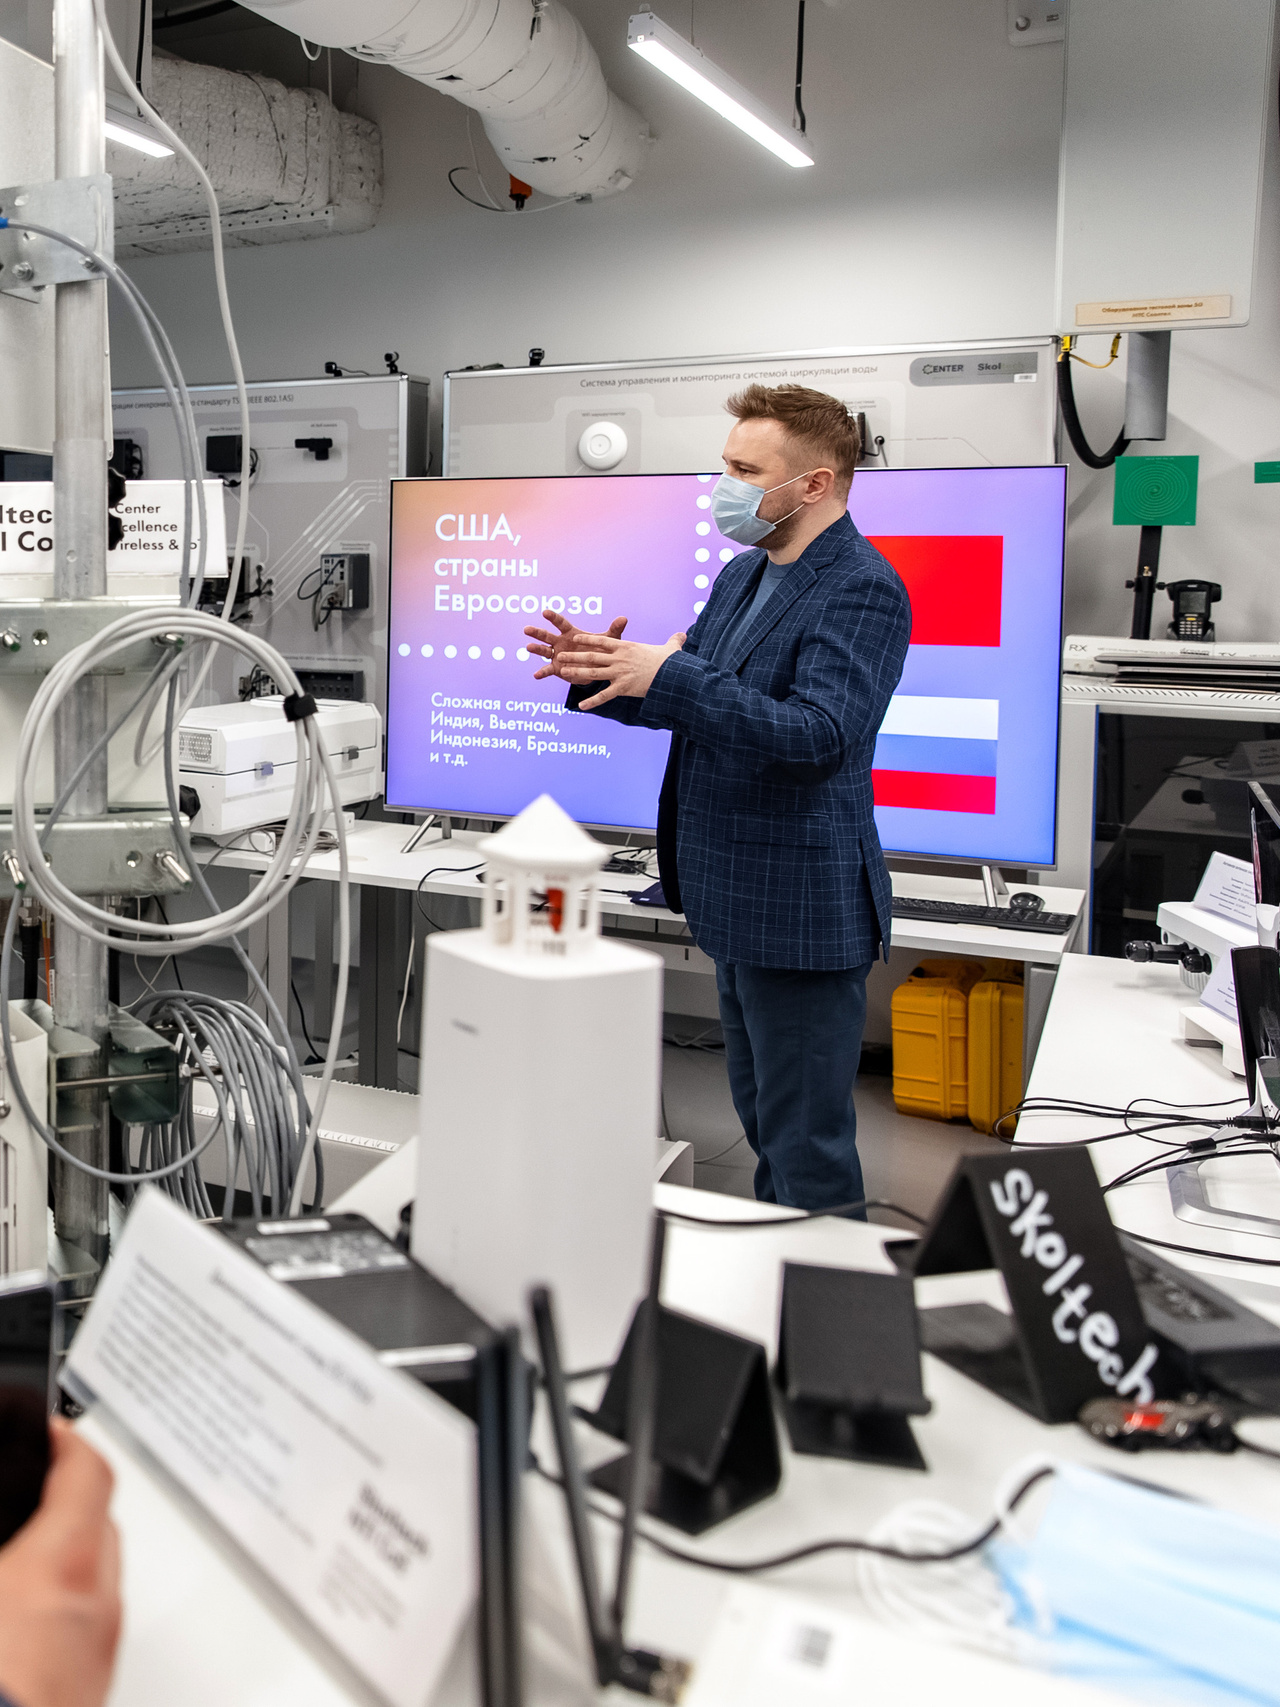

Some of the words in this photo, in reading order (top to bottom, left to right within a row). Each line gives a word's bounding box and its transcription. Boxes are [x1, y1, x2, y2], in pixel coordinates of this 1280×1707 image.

[580, 378, 616, 388] Система
[617, 377, 671, 387] управления
[680, 372, 741, 383] мониторинга
[742, 368, 788, 379] системой
[789, 365, 850, 378] циркуляции
[851, 364, 879, 375] воды
[115, 503, 161, 514] Center
[121, 520, 178, 532] cellence
[435, 513, 522, 547] США,
[17, 531, 53, 552] Co
[120, 538, 164, 550] ireless
[168, 539, 179, 550] &
[434, 558, 539, 585] страны
[434, 584, 603, 621] Евросоюза
[1069, 644, 1087, 652] RX
[431, 692, 501, 711] Сложная
[505, 699, 586, 717] ситуац
[430, 710, 485, 732] Индия,
[489, 713, 561, 736] Вьетнам,
[430, 729, 522, 753] Индонезия,
[527, 735, 612, 759] Бразилия,
[429, 752, 439, 763] и
[443, 753, 469, 767] т.д.
